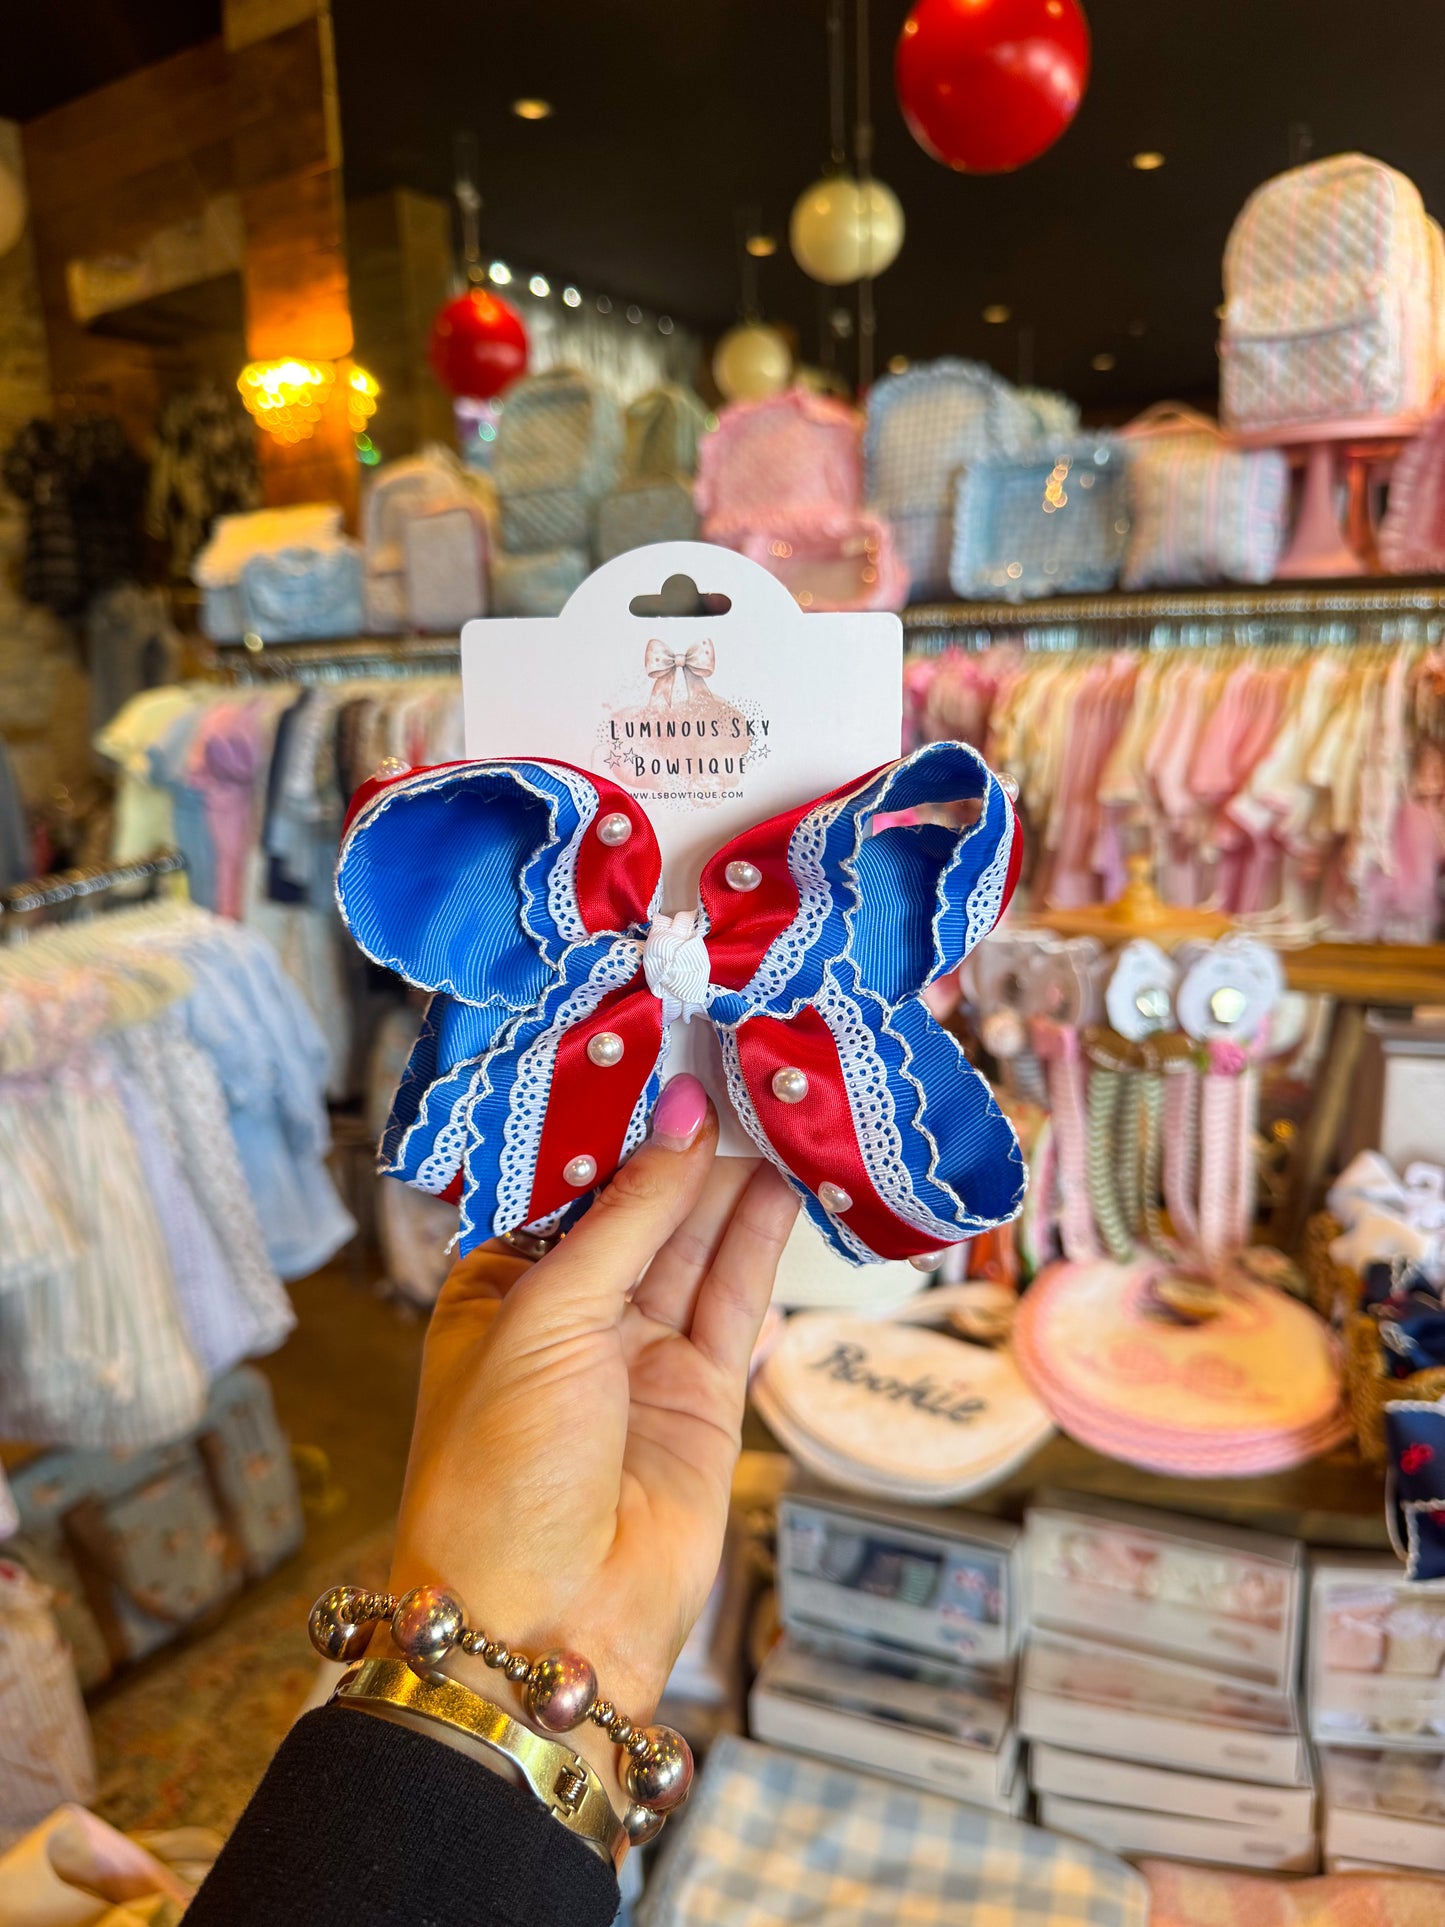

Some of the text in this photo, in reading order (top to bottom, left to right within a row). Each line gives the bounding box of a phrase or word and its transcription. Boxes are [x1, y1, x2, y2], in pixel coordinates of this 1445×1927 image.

[611, 718, 770, 741] LUMINOUS SKY
[635, 757, 746, 777] BOWTIQUE
[630, 791, 744, 799] WW.LSBOWTIQUE.COM
